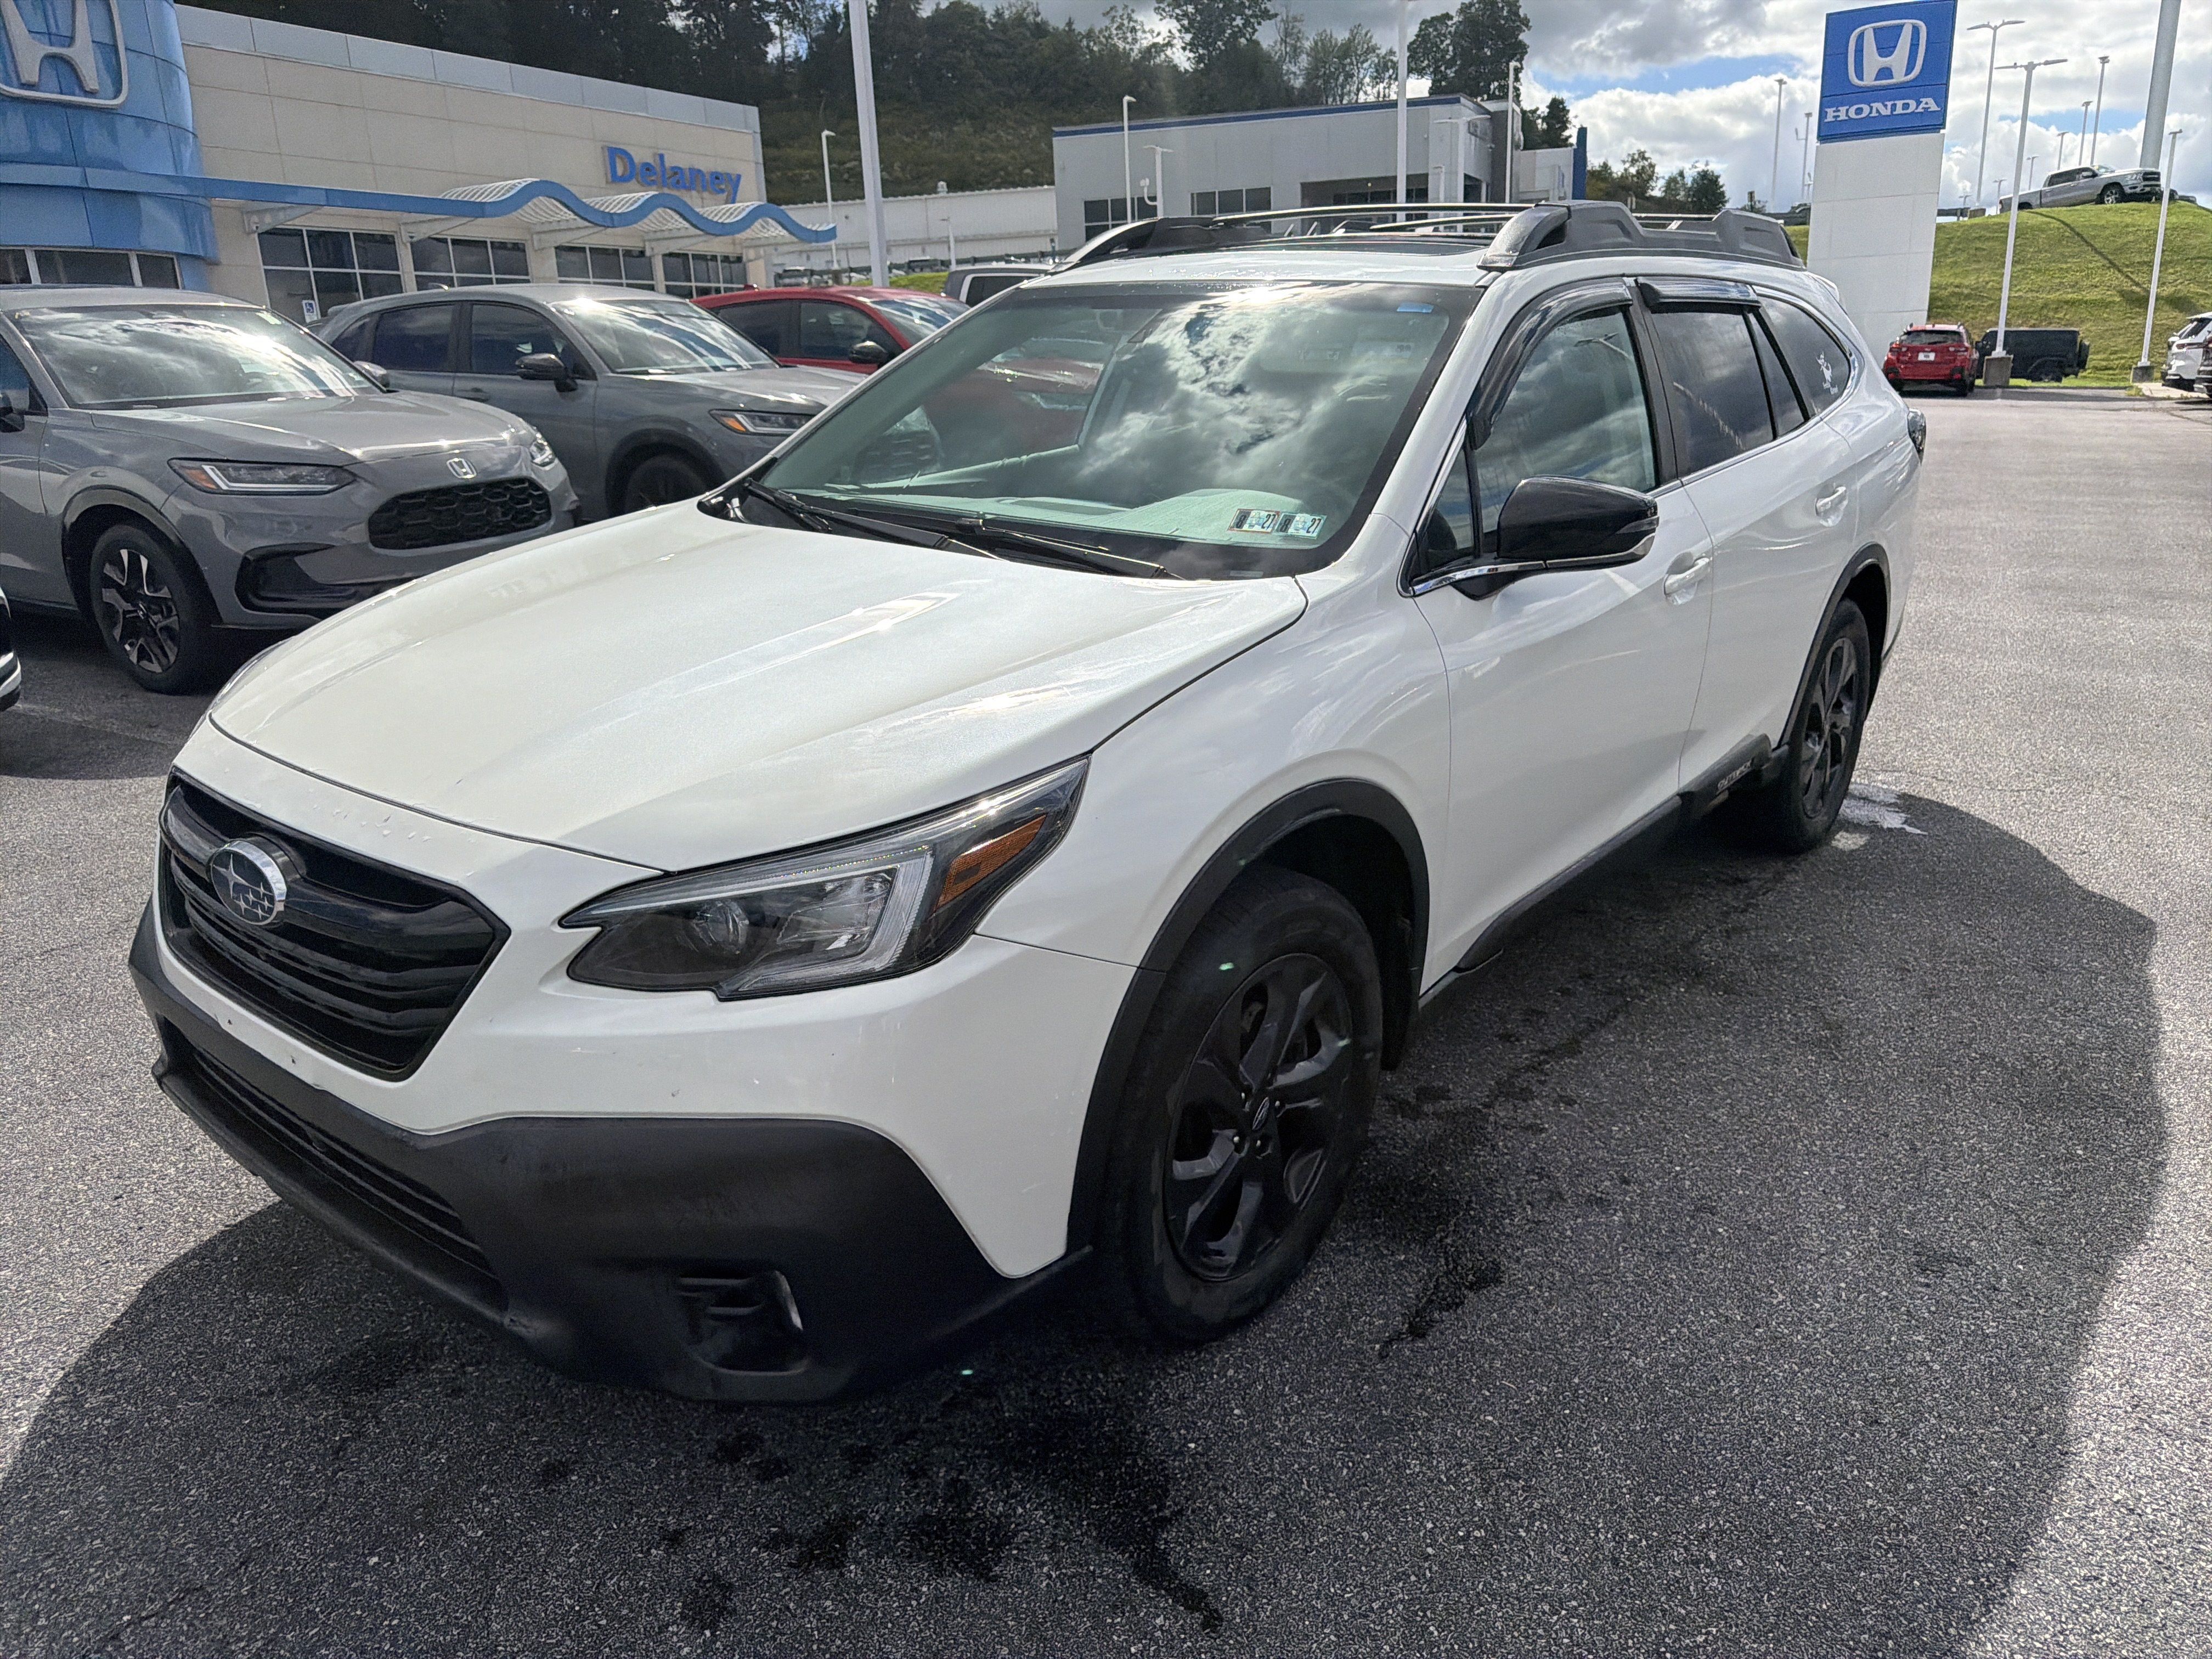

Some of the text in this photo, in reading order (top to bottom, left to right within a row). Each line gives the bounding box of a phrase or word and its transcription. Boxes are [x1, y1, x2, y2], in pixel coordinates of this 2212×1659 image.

[1824, 97, 1941, 122] HONDA
[607, 146, 742, 204] Delaney
[1235, 514, 1276, 529] 8 27
[1279, 518, 1322, 534] 8 27
